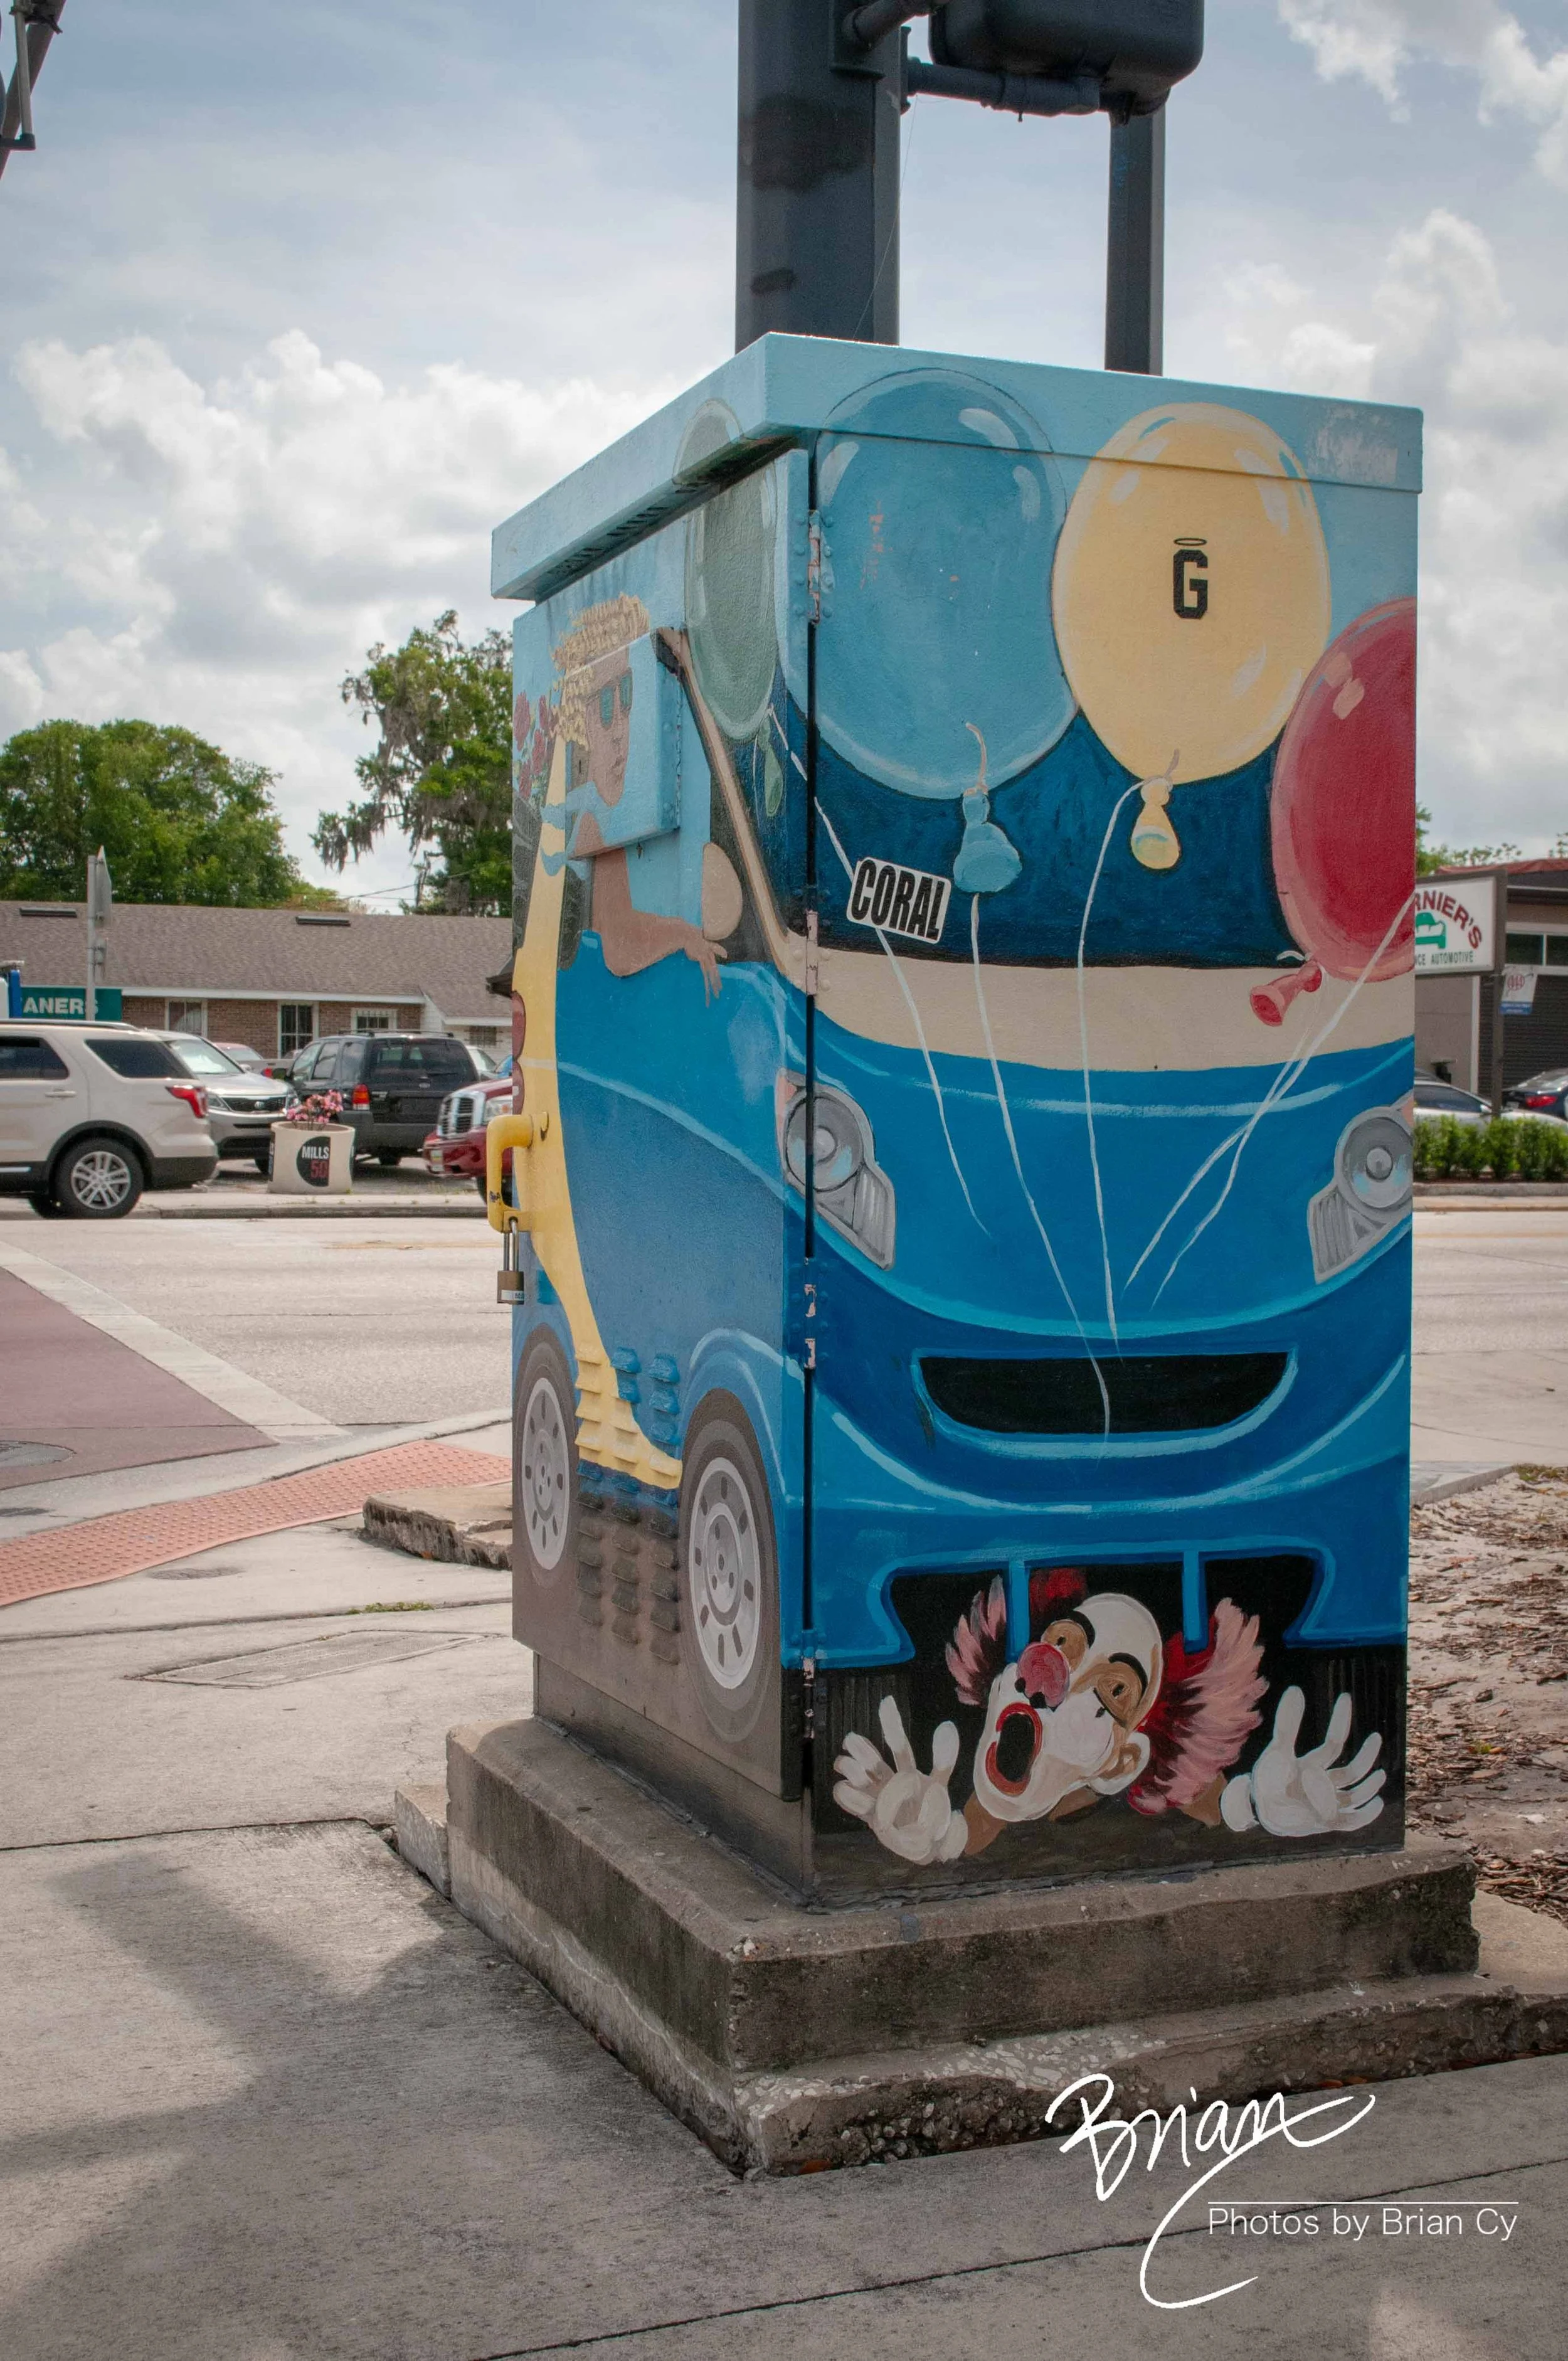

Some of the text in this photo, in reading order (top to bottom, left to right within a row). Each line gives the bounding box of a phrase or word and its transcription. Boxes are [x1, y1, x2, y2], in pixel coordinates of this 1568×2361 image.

[1173, 549, 1209, 620] G
[850, 858, 945, 940] CORAL
[1431, 950, 1473, 965] AUTOMOTIVE
[23, 997, 98, 1015] ANER
[302, 1145, 329, 1160] MILLS
[310, 1160, 329, 1178] 50
